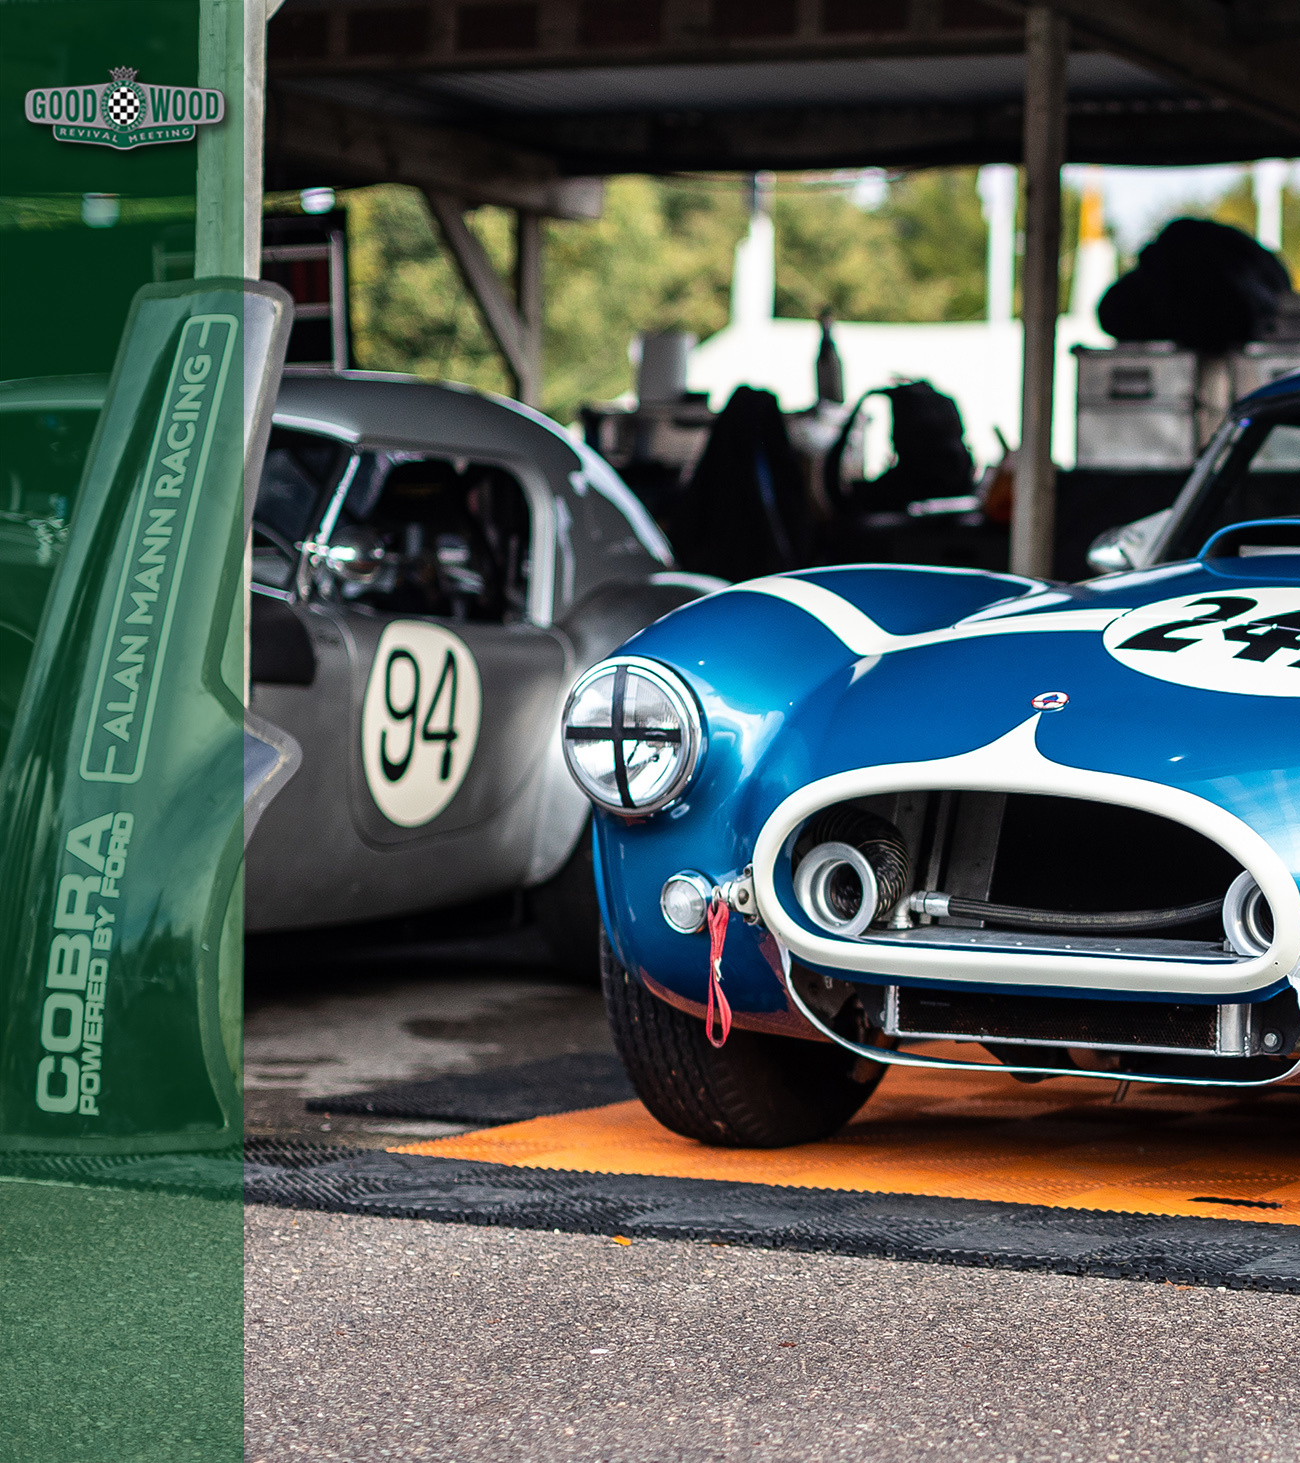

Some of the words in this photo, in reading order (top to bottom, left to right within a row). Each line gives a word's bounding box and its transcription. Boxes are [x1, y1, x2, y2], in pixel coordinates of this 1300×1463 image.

[154, 354, 212, 500] RACING
[125, 507, 178, 625] MANN
[102, 634, 150, 743] ALAN
[380, 649, 458, 782] 94
[101, 811, 135, 898] FORD
[36, 811, 114, 1115] COBRA
[93, 904, 116, 951] BY
[79, 957, 110, 1117] POWERED
